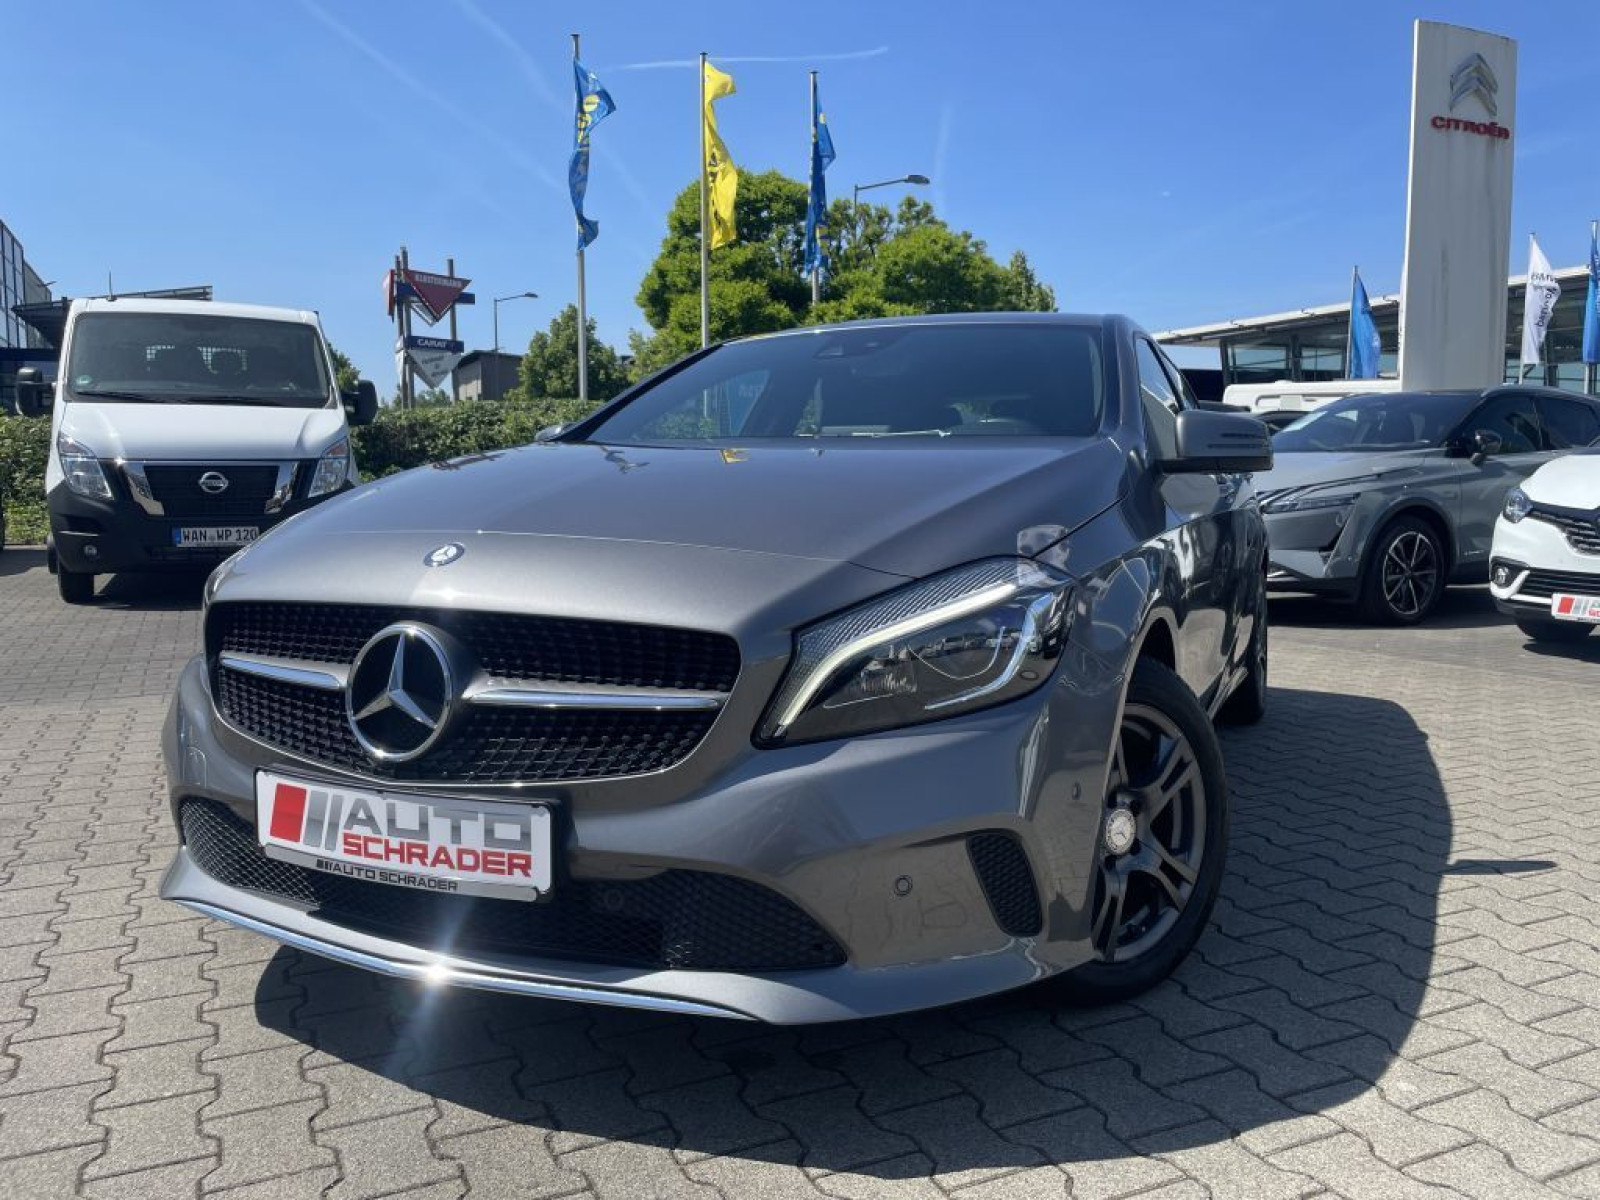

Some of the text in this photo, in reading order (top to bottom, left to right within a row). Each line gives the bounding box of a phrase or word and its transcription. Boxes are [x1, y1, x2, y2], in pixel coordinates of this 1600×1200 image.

[182, 529, 258, 542] WAN WP 120
[343, 797, 532, 852] AUTO
[342, 832, 532, 878] SCHRADER
[331, 863, 459, 892] AUTO SCHRADER
